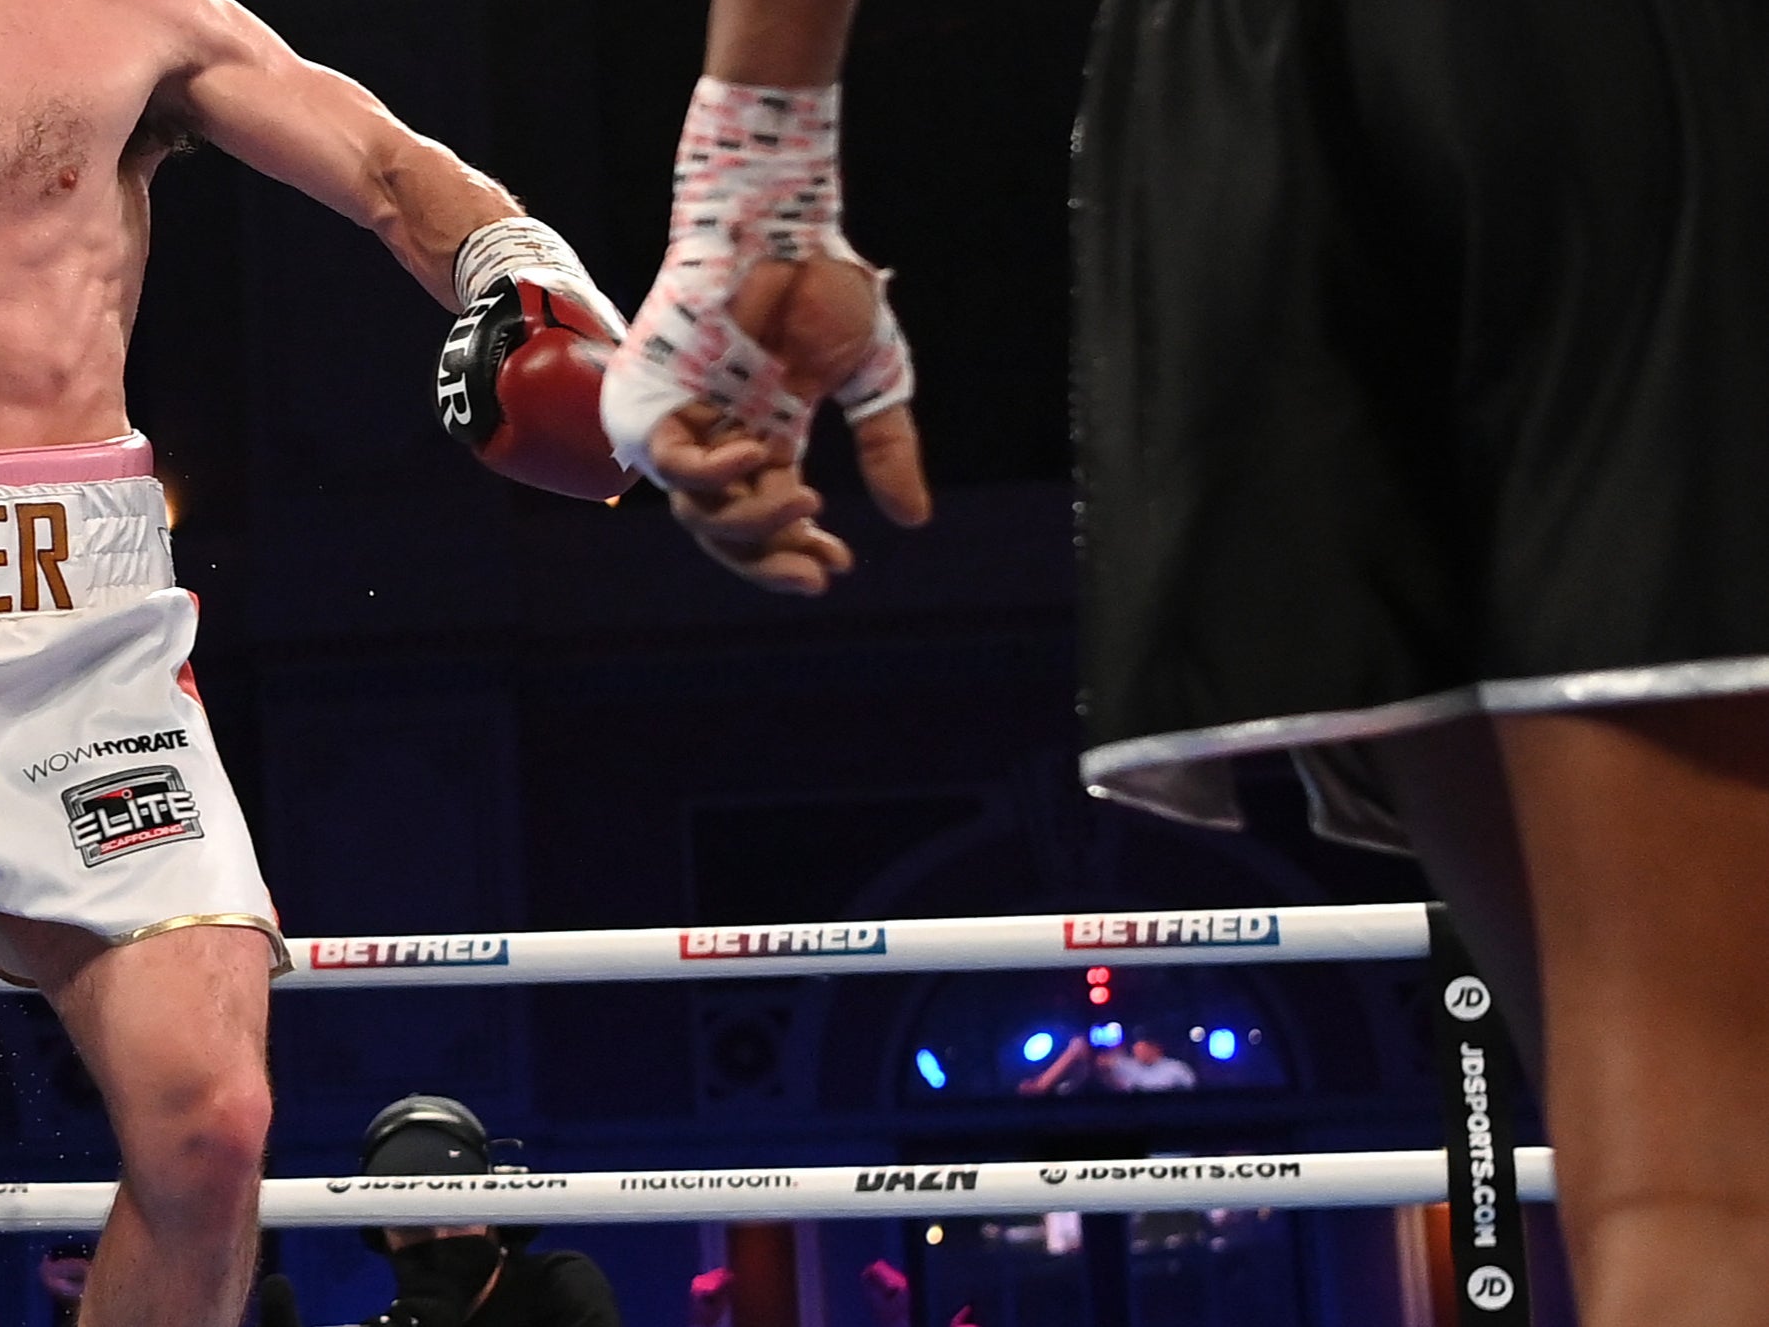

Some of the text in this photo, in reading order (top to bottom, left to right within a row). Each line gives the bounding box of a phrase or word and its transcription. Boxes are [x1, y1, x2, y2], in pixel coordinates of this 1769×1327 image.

[99, 825, 185, 853] SCAFFOLDING
[686, 926, 879, 954] BETFRED
[1072, 913, 1272, 944] BETFRED
[316, 936, 502, 964] BETFRED
[1460, 1041, 1497, 1248] JDSPORTS.COM
[854, 1169, 979, 1192] DAZN
[1075, 1161, 1301, 1180] JDSPORTS.COM
